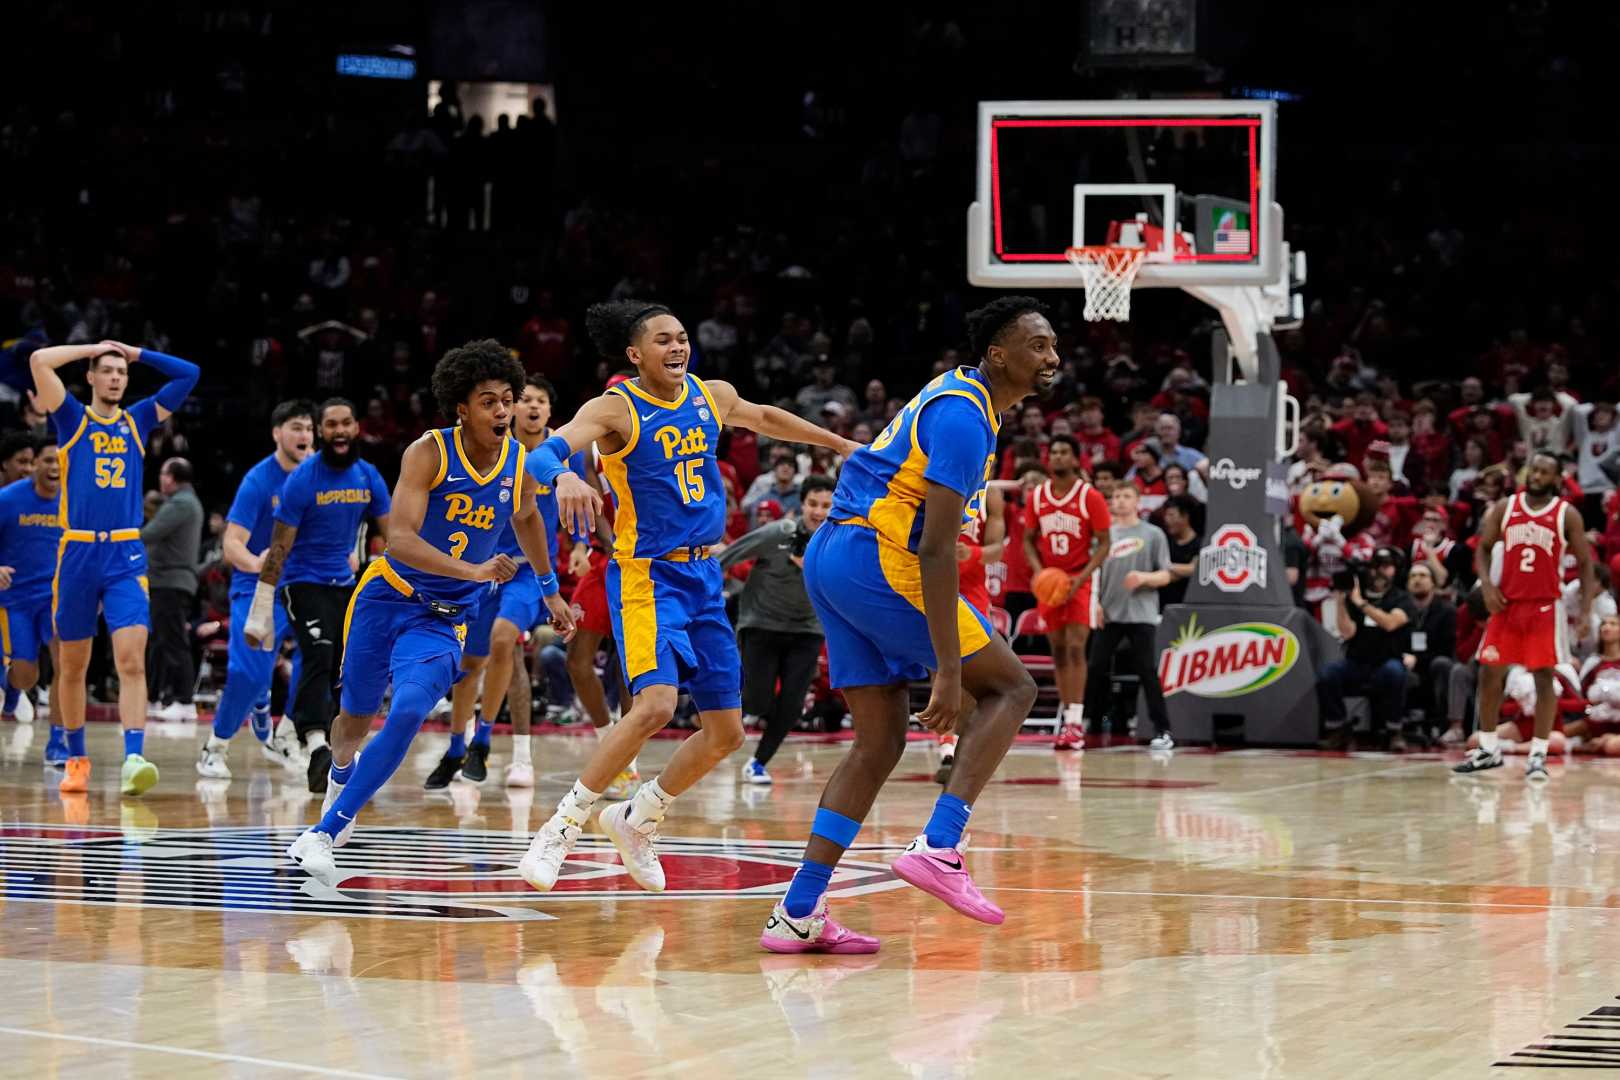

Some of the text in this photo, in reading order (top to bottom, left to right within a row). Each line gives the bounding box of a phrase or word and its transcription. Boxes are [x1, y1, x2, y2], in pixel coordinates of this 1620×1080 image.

[89, 431, 128, 454] Pitt
[654, 425, 709, 460] Pitt
[95, 457, 126, 488] 52
[674, 458, 706, 505] 15
[444, 493, 496, 529] Pitt
[1050, 533, 1070, 556] 13
[1519, 547, 1536, 573] 2
[1160, 637, 1286, 693] LIBMAN
